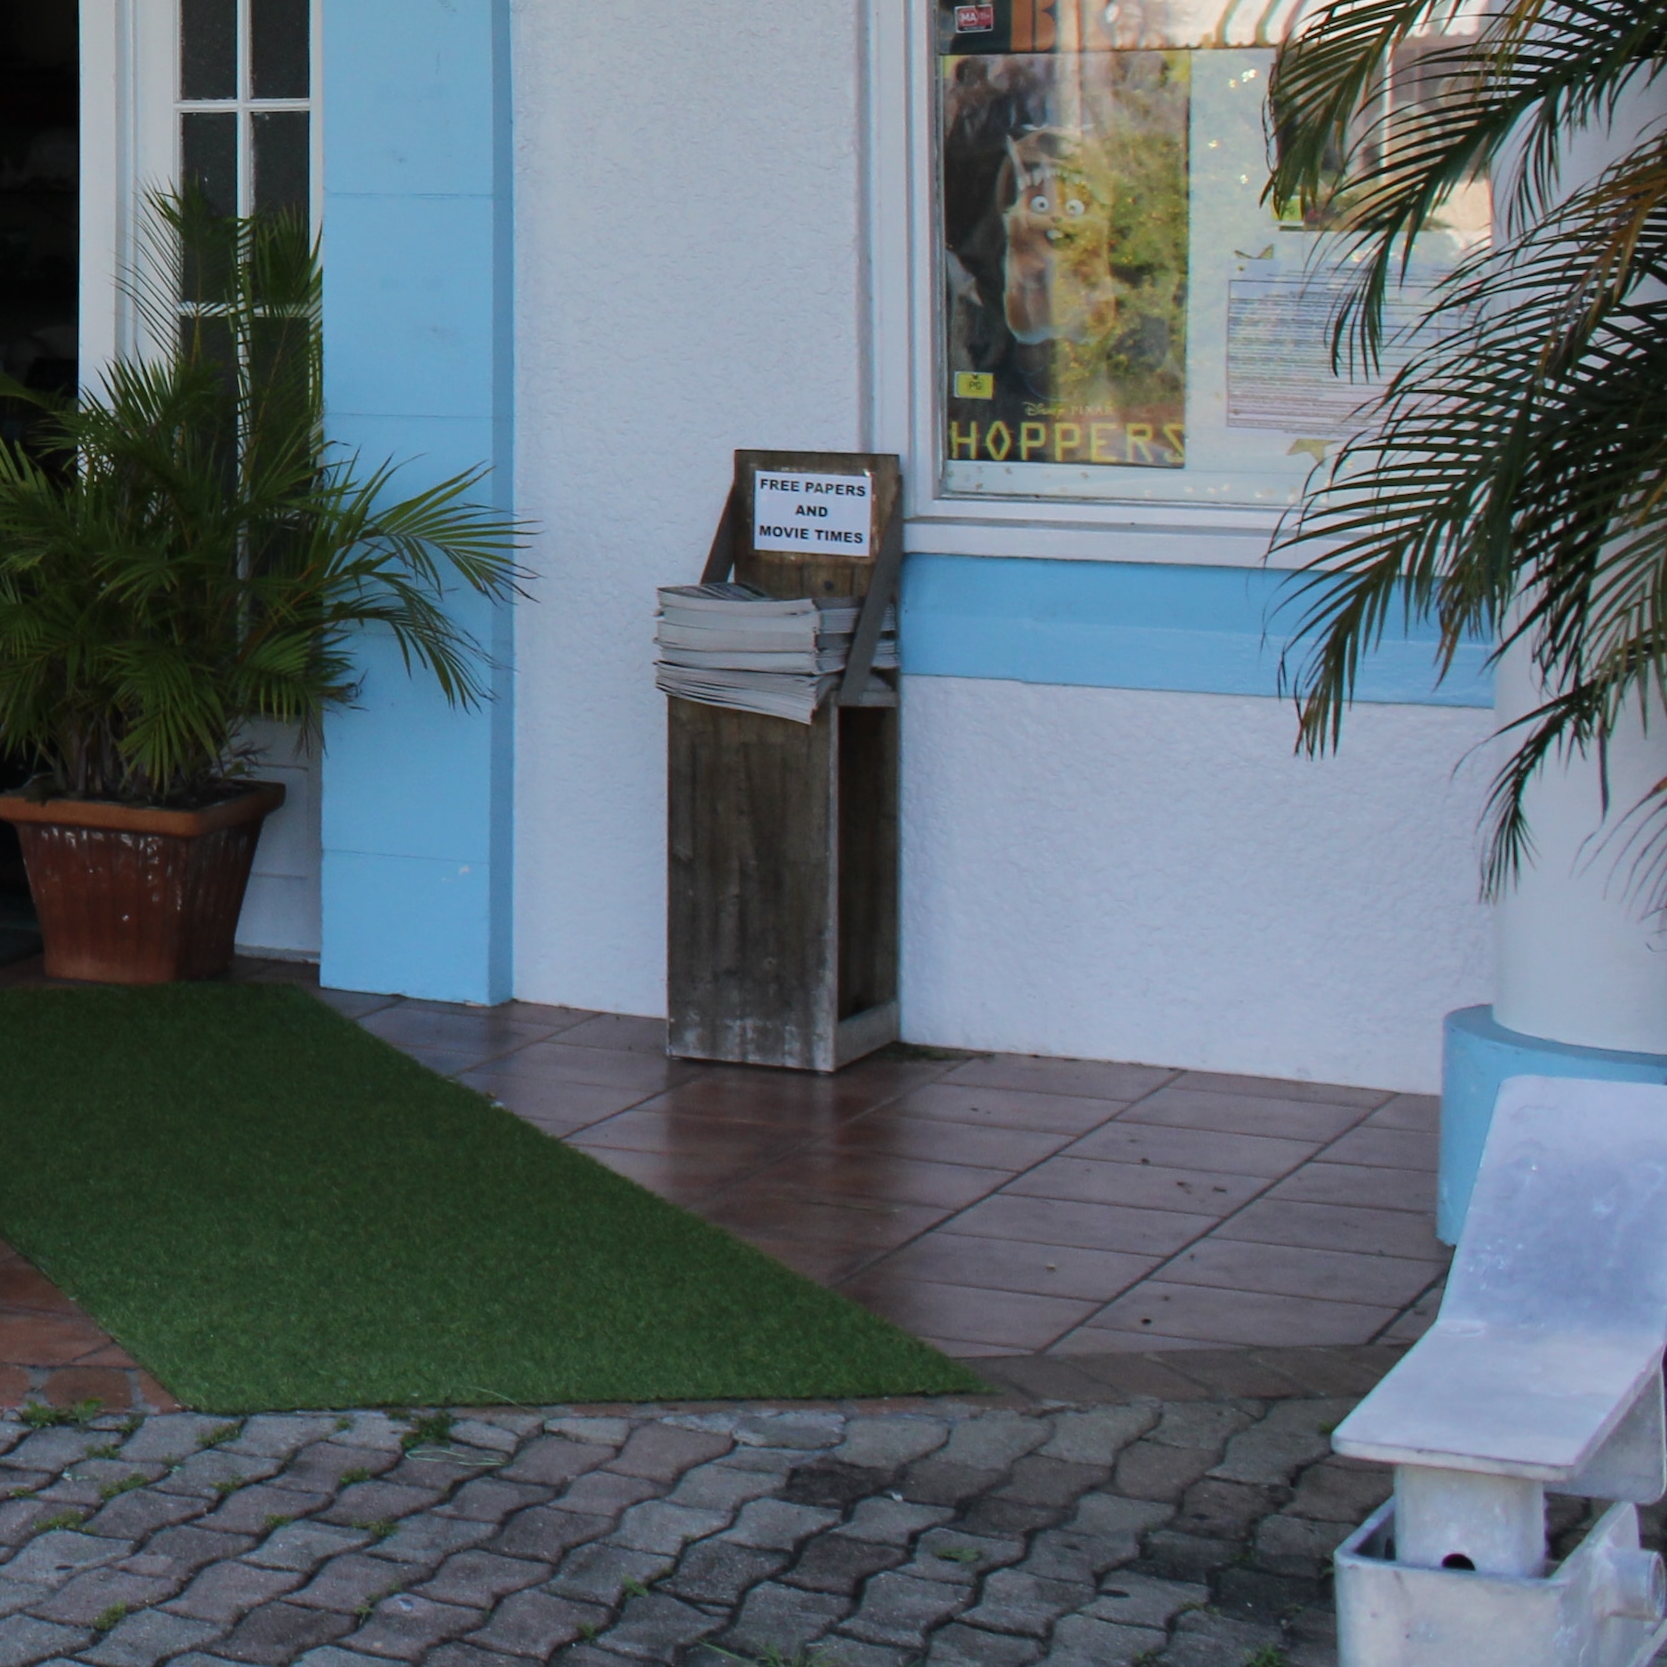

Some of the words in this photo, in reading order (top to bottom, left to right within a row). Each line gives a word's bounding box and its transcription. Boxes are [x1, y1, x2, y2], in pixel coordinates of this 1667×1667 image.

[968, 380, 982, 391] PG
[1070, 405, 1114, 416] PIXAR
[950, 420, 1184, 464] HOPPERS
[760, 478, 800, 492] FREE
[805, 481, 866, 497] PAPERS
[795, 504, 828, 517] AND
[759, 525, 809, 540] MOVIE
[814, 529, 864, 543] TIMES
